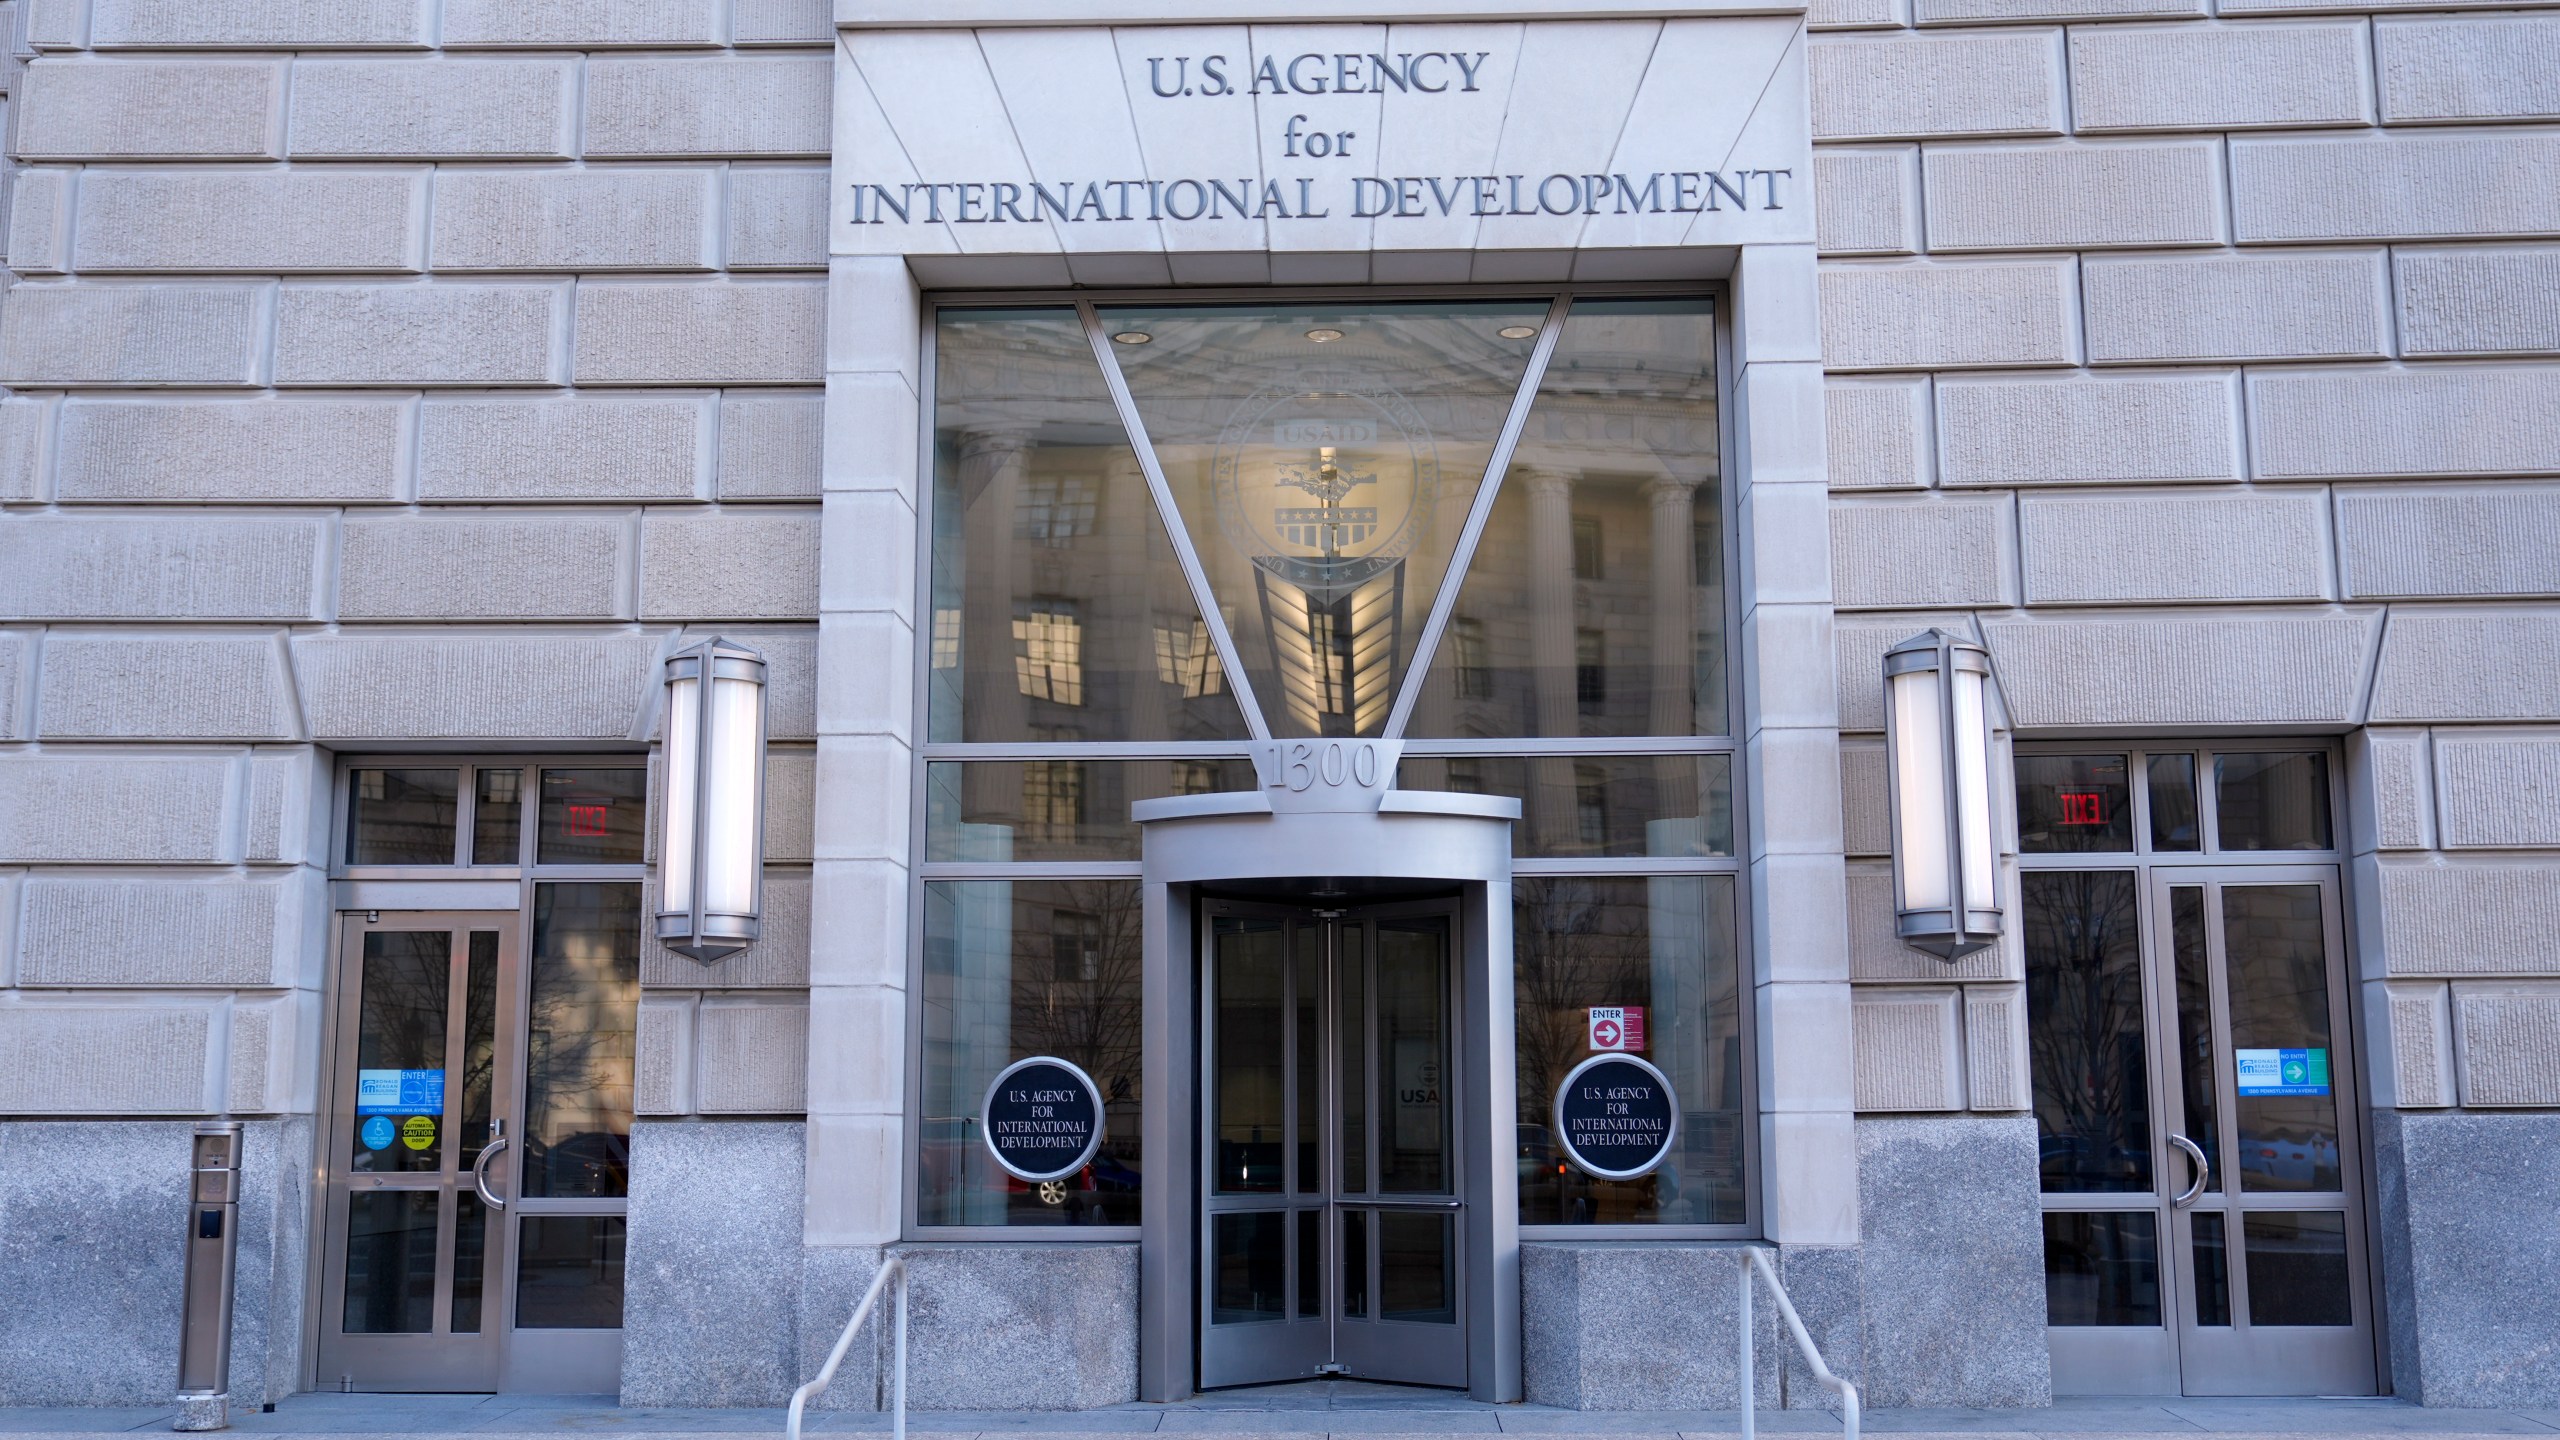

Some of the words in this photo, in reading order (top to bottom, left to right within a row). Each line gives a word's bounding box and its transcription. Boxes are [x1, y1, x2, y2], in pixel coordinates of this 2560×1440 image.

[1146, 55, 1235, 98] U.S.
[1247, 52, 1490, 95] AGENCY
[1283, 113, 1356, 158] for
[850, 176, 1330, 225] INTERNATIONAL
[1351, 167, 1792, 218] DEVELOPMENT
[1281, 424, 1371, 443] USAID
[1268, 743, 1380, 792] 1300
[1592, 1009, 1621, 1019] ENTER
[1009, 1090, 1028, 1103] U.S.
[1031, 1089, 1077, 1103] AGENCY
[1583, 1088, 1603, 1100] U.S.
[1606, 1087, 1651, 1100] AGENCY
[1031, 1105, 1054, 1118] FOR
[1606, 1102, 1629, 1115] FOR
[997, 1120, 1087, 1133] INTERNATIONAL
[1572, 1118, 1664, 1130] INTERNATIONAL
[1000, 1136, 1084, 1148] DEVELOPMENT
[1576, 1133, 1660, 1146] DEVELOPMENT
